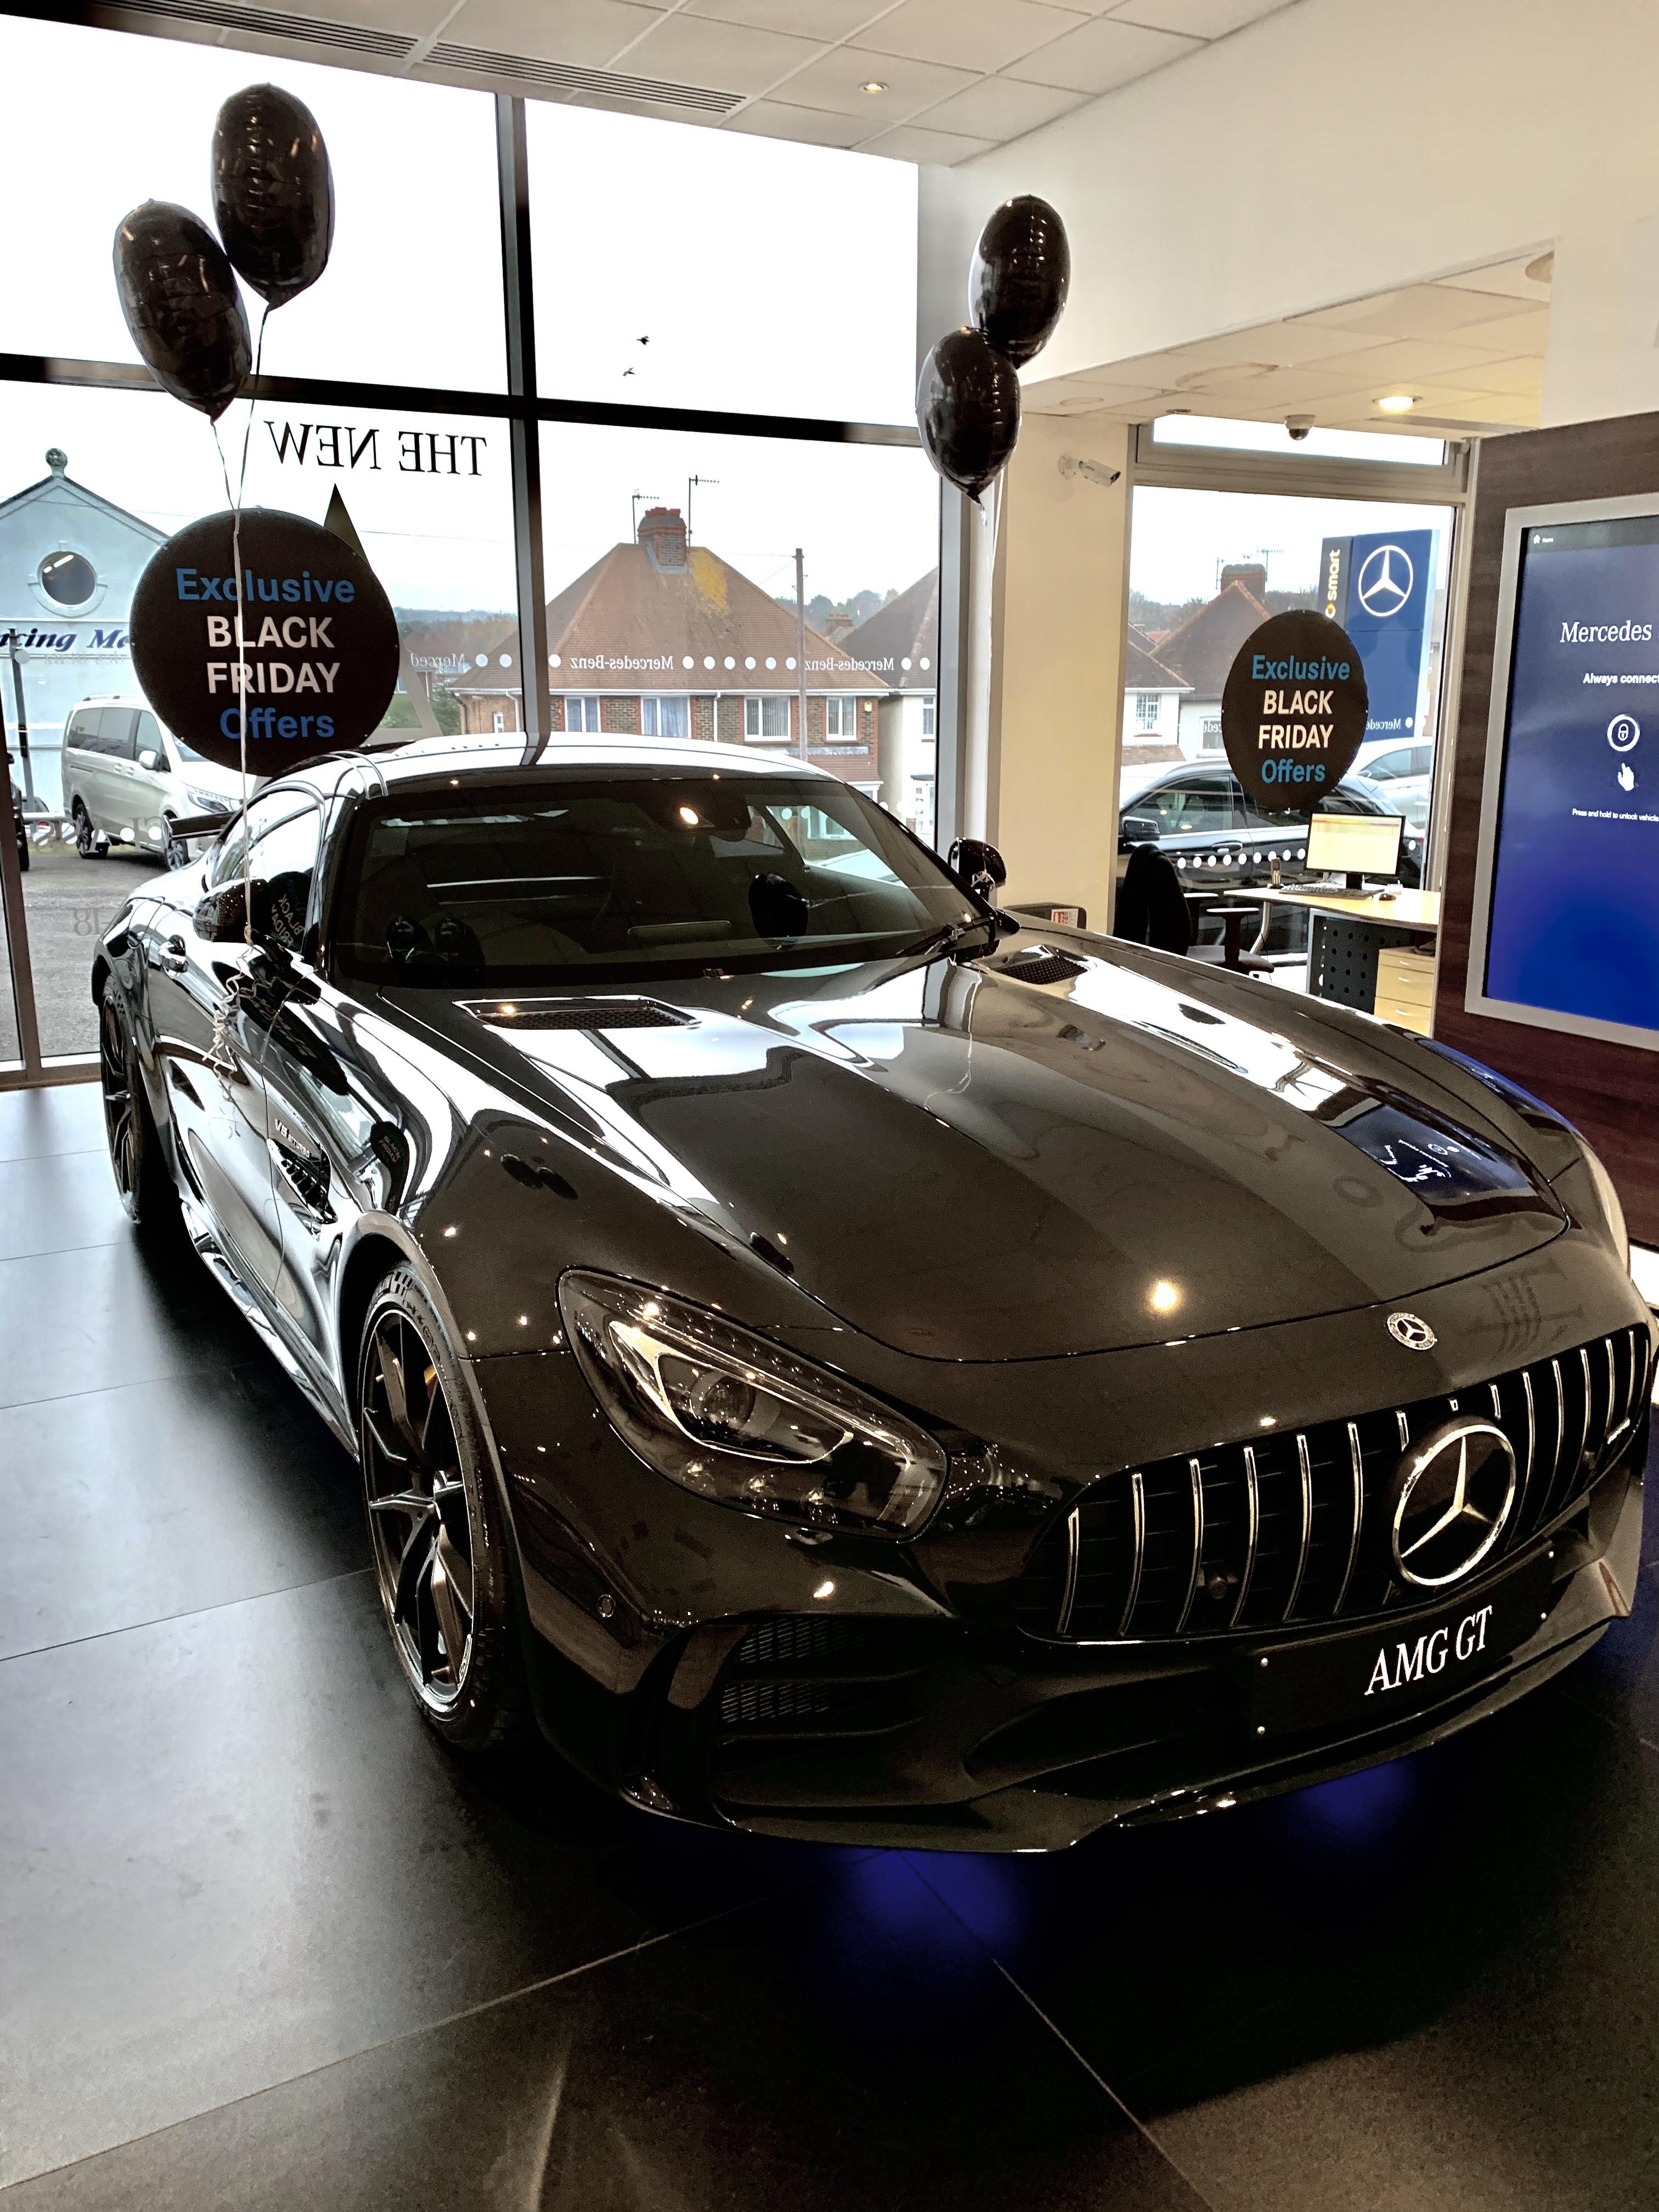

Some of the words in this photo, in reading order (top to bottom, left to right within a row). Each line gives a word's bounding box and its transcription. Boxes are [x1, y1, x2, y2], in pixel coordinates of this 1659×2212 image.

[176, 567, 356, 603] Exclusive
[1328, 549, 1341, 601] smart
[207, 616, 335, 649] BLACK
[1560, 620, 1652, 642] Mercedes
[207, 662, 341, 695] FRIDAY
[1252, 654, 1350, 681] Exclusive
[1583, 673, 1618, 686] Always
[1263, 690, 1334, 715] BLACK
[219, 707, 335, 740] Offers
[1258, 725, 1334, 749] FRIDAY
[1261, 758, 1326, 783] Offers
[1364, 1628, 1449, 1696] AMG
[1455, 1605, 1492, 1662] GT
